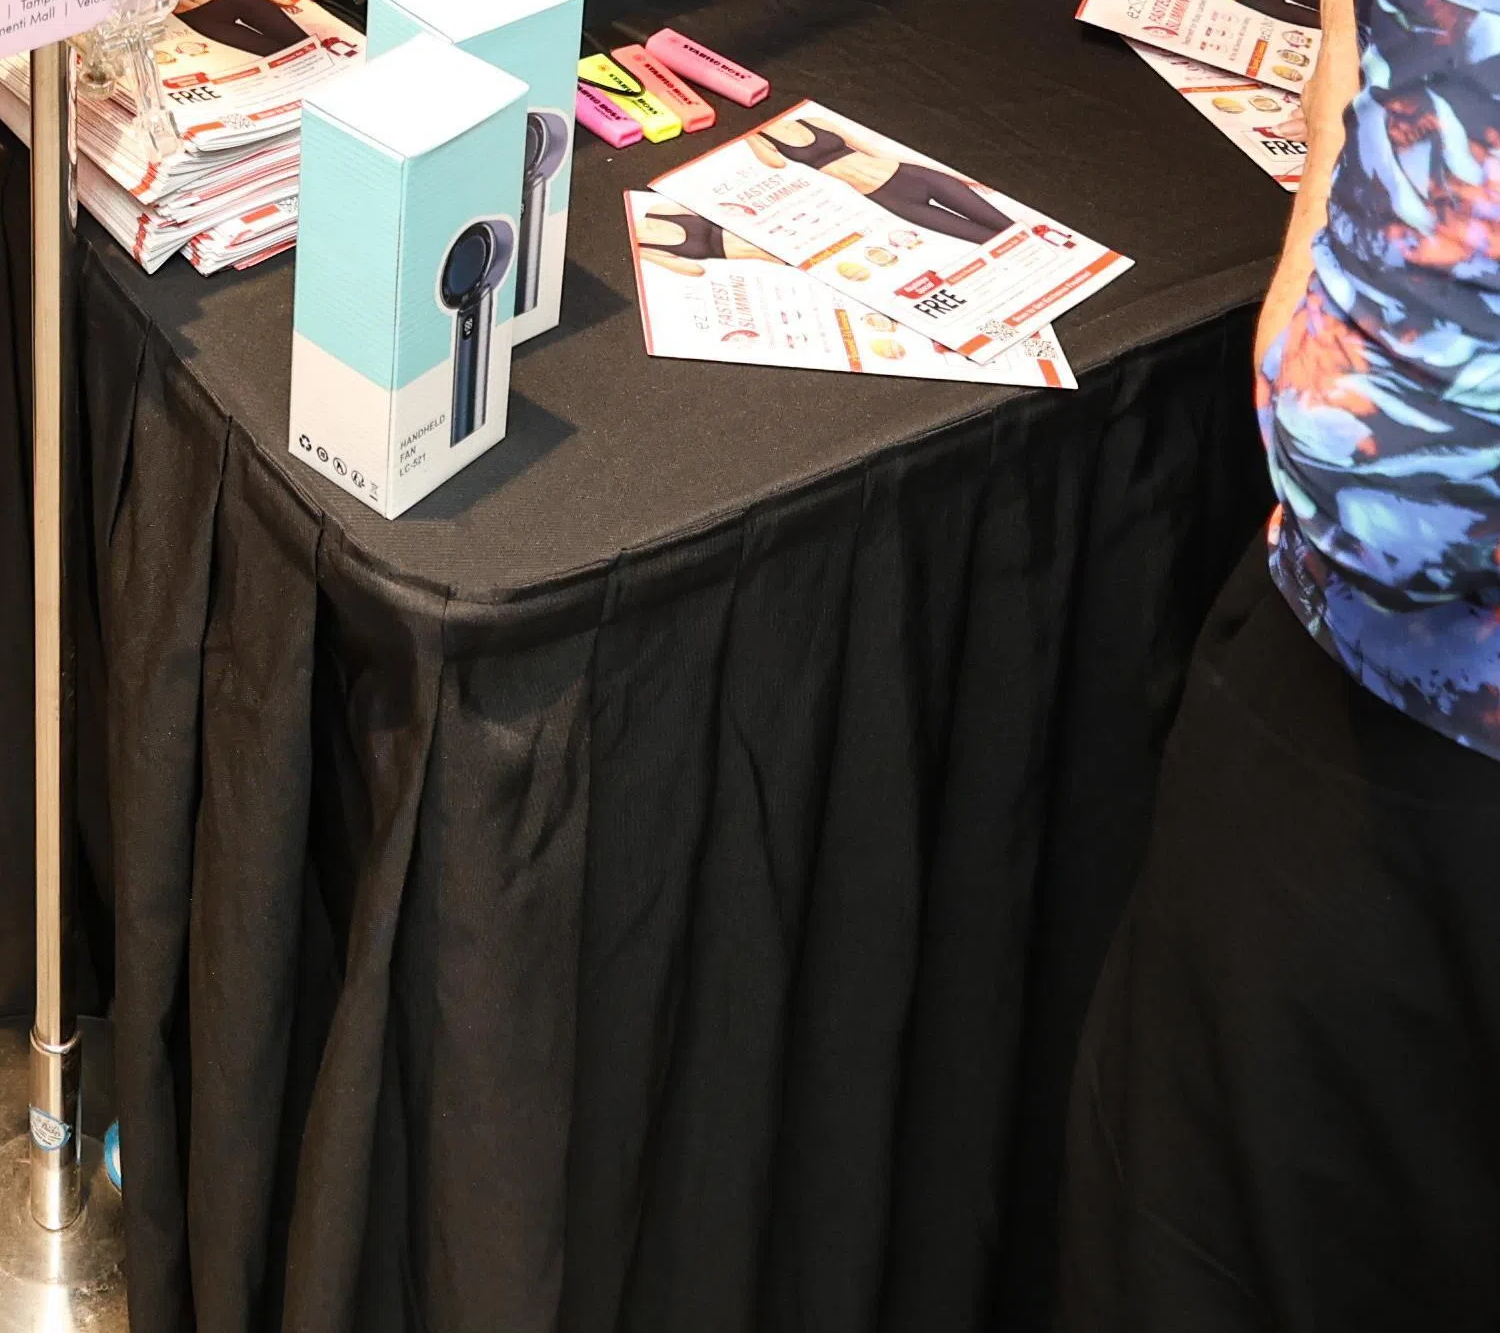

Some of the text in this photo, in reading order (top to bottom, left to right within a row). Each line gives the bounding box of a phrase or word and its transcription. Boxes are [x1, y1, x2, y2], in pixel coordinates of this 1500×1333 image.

[721, 63, 748, 80] BOSS
[168, 85, 223, 106] FREE
[736, 174, 785, 206] FASTEST
[914, 288, 968, 320] FREE
[400, 414, 446, 450] HANDHELD
[400, 445, 416, 463] FAN
